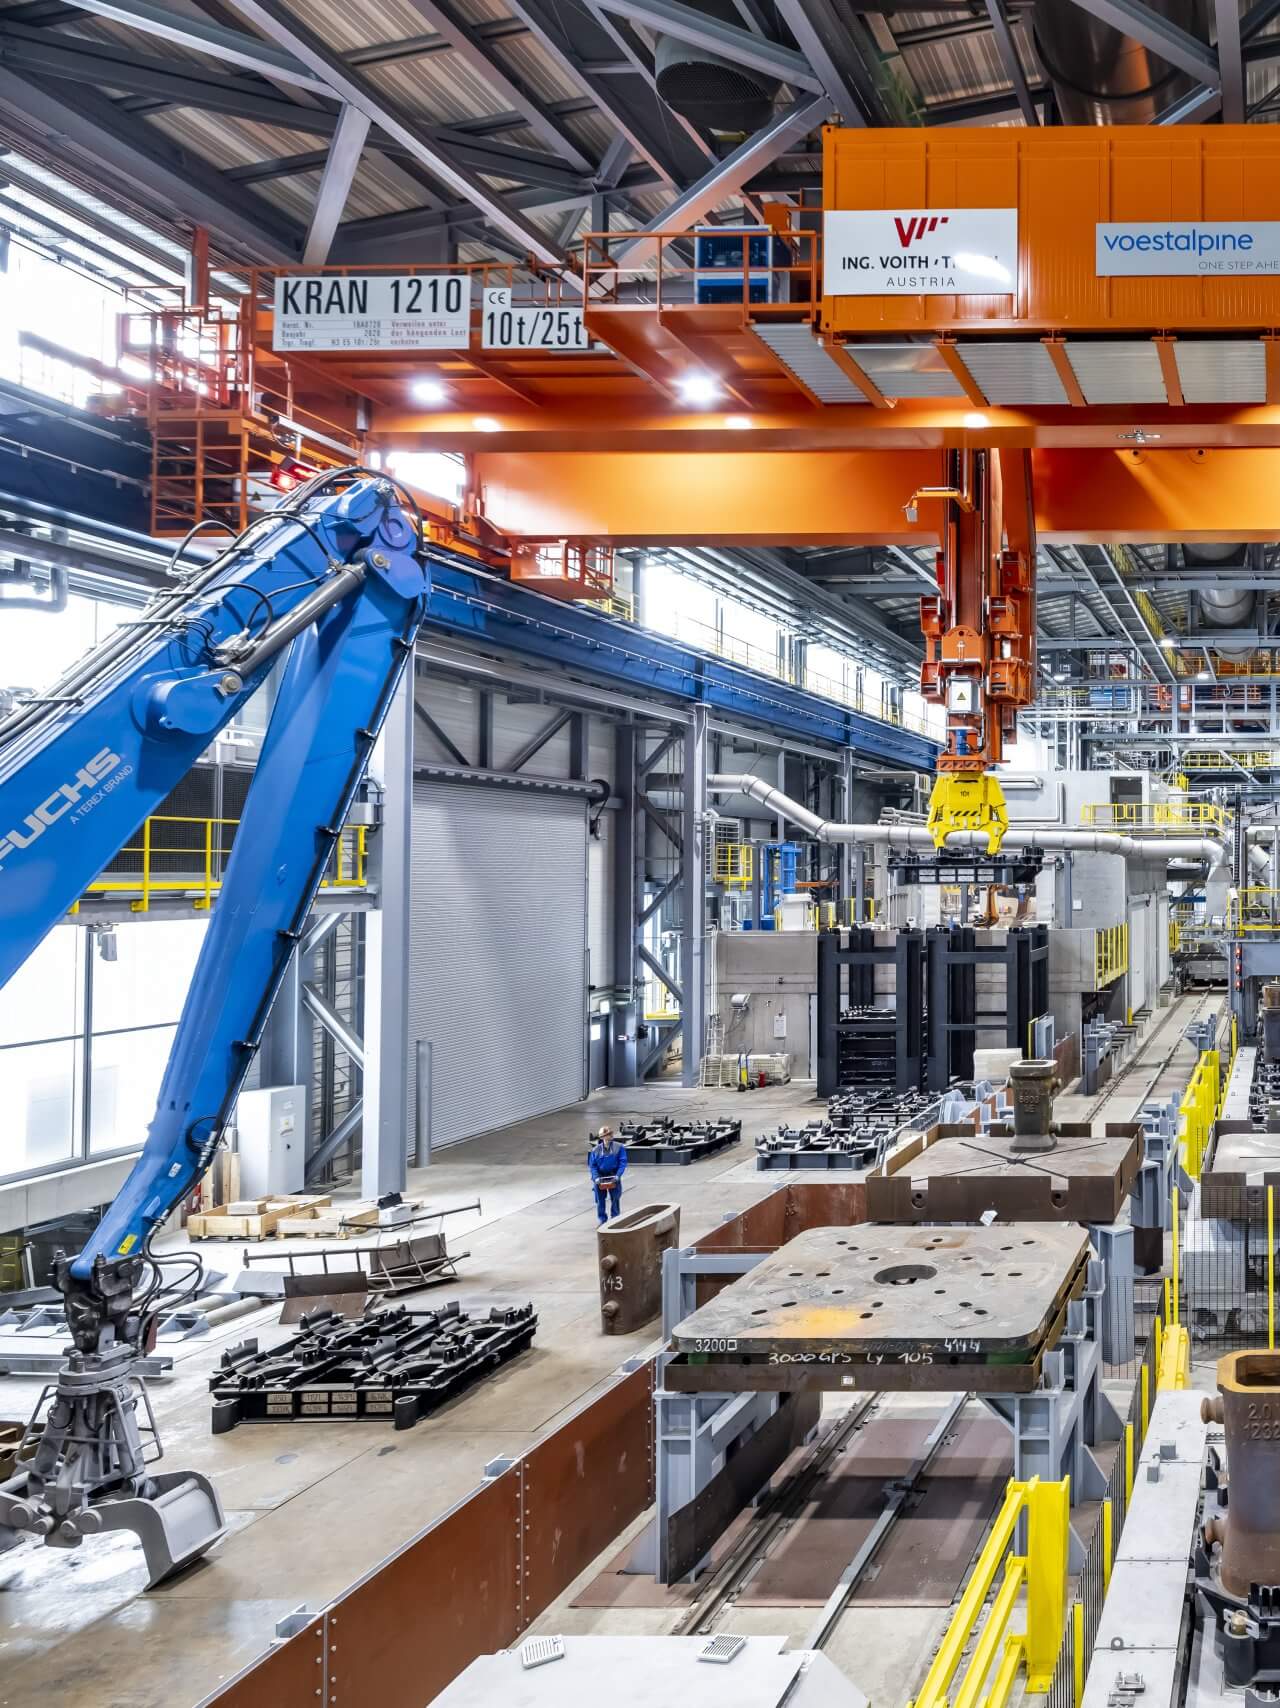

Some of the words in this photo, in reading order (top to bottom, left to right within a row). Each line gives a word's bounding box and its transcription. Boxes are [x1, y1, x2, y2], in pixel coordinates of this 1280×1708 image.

[1104, 229, 1254, 257] voestalpine
[842, 257, 875, 270] ING.
[879, 255, 929, 269] VOITH
[1198, 260, 1225, 270] ONE
[1228, 260, 1254, 270] STEP
[886, 276, 956, 287] AUSTRIA
[282, 280, 368, 315] KRAN
[390, 278, 462, 313] 1210
[487, 311, 583, 346] 10t/25t
[69, 815, 80, 825] A
[75, 789, 107, 817] TEREX
[103, 764, 134, 793] BRAND
[898, 1352, 934, 1365] 105
